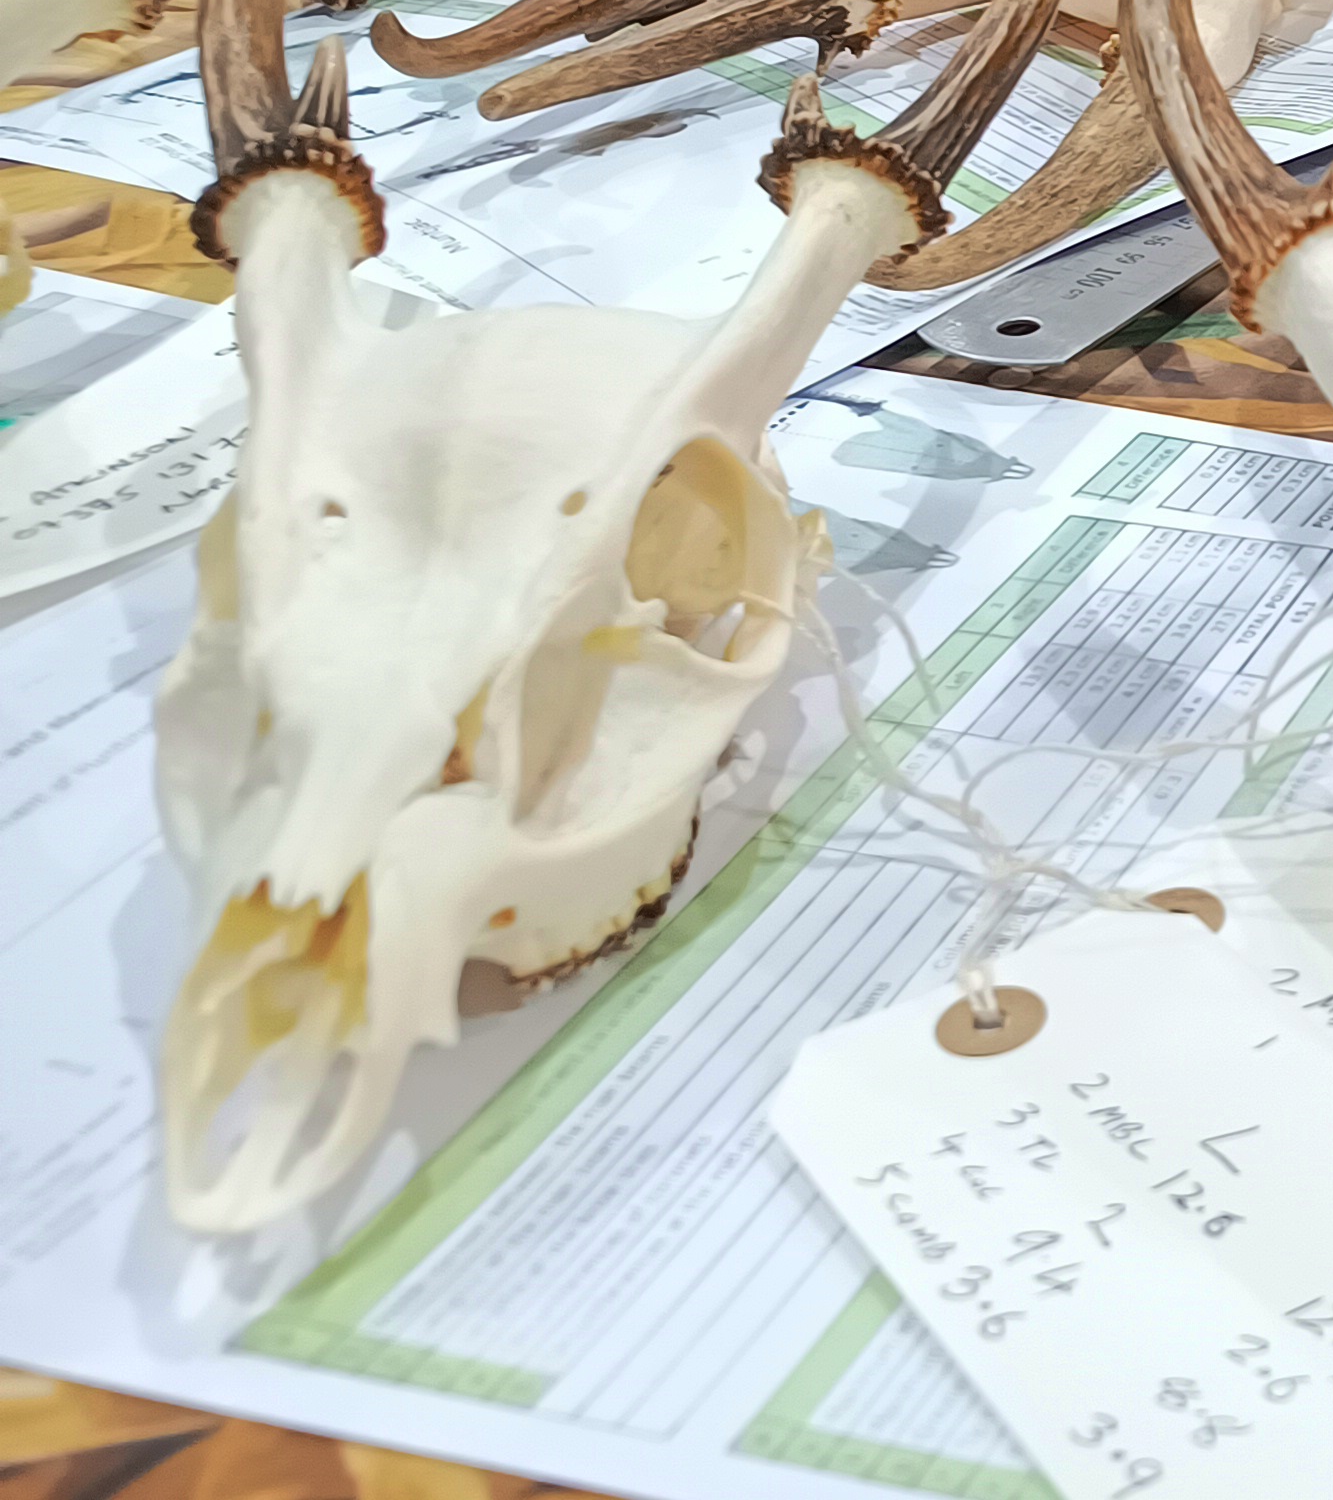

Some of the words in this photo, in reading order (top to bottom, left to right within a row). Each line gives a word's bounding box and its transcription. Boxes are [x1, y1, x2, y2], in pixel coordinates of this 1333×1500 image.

[1076, 267, 1122, 289] 100
[1235, 603, 1273, 645] TOTAL
[1068, 1071, 1111, 1102] 2
[995, 1100, 1042, 1129] 3
[1198, 1123, 1263, 1177] L
